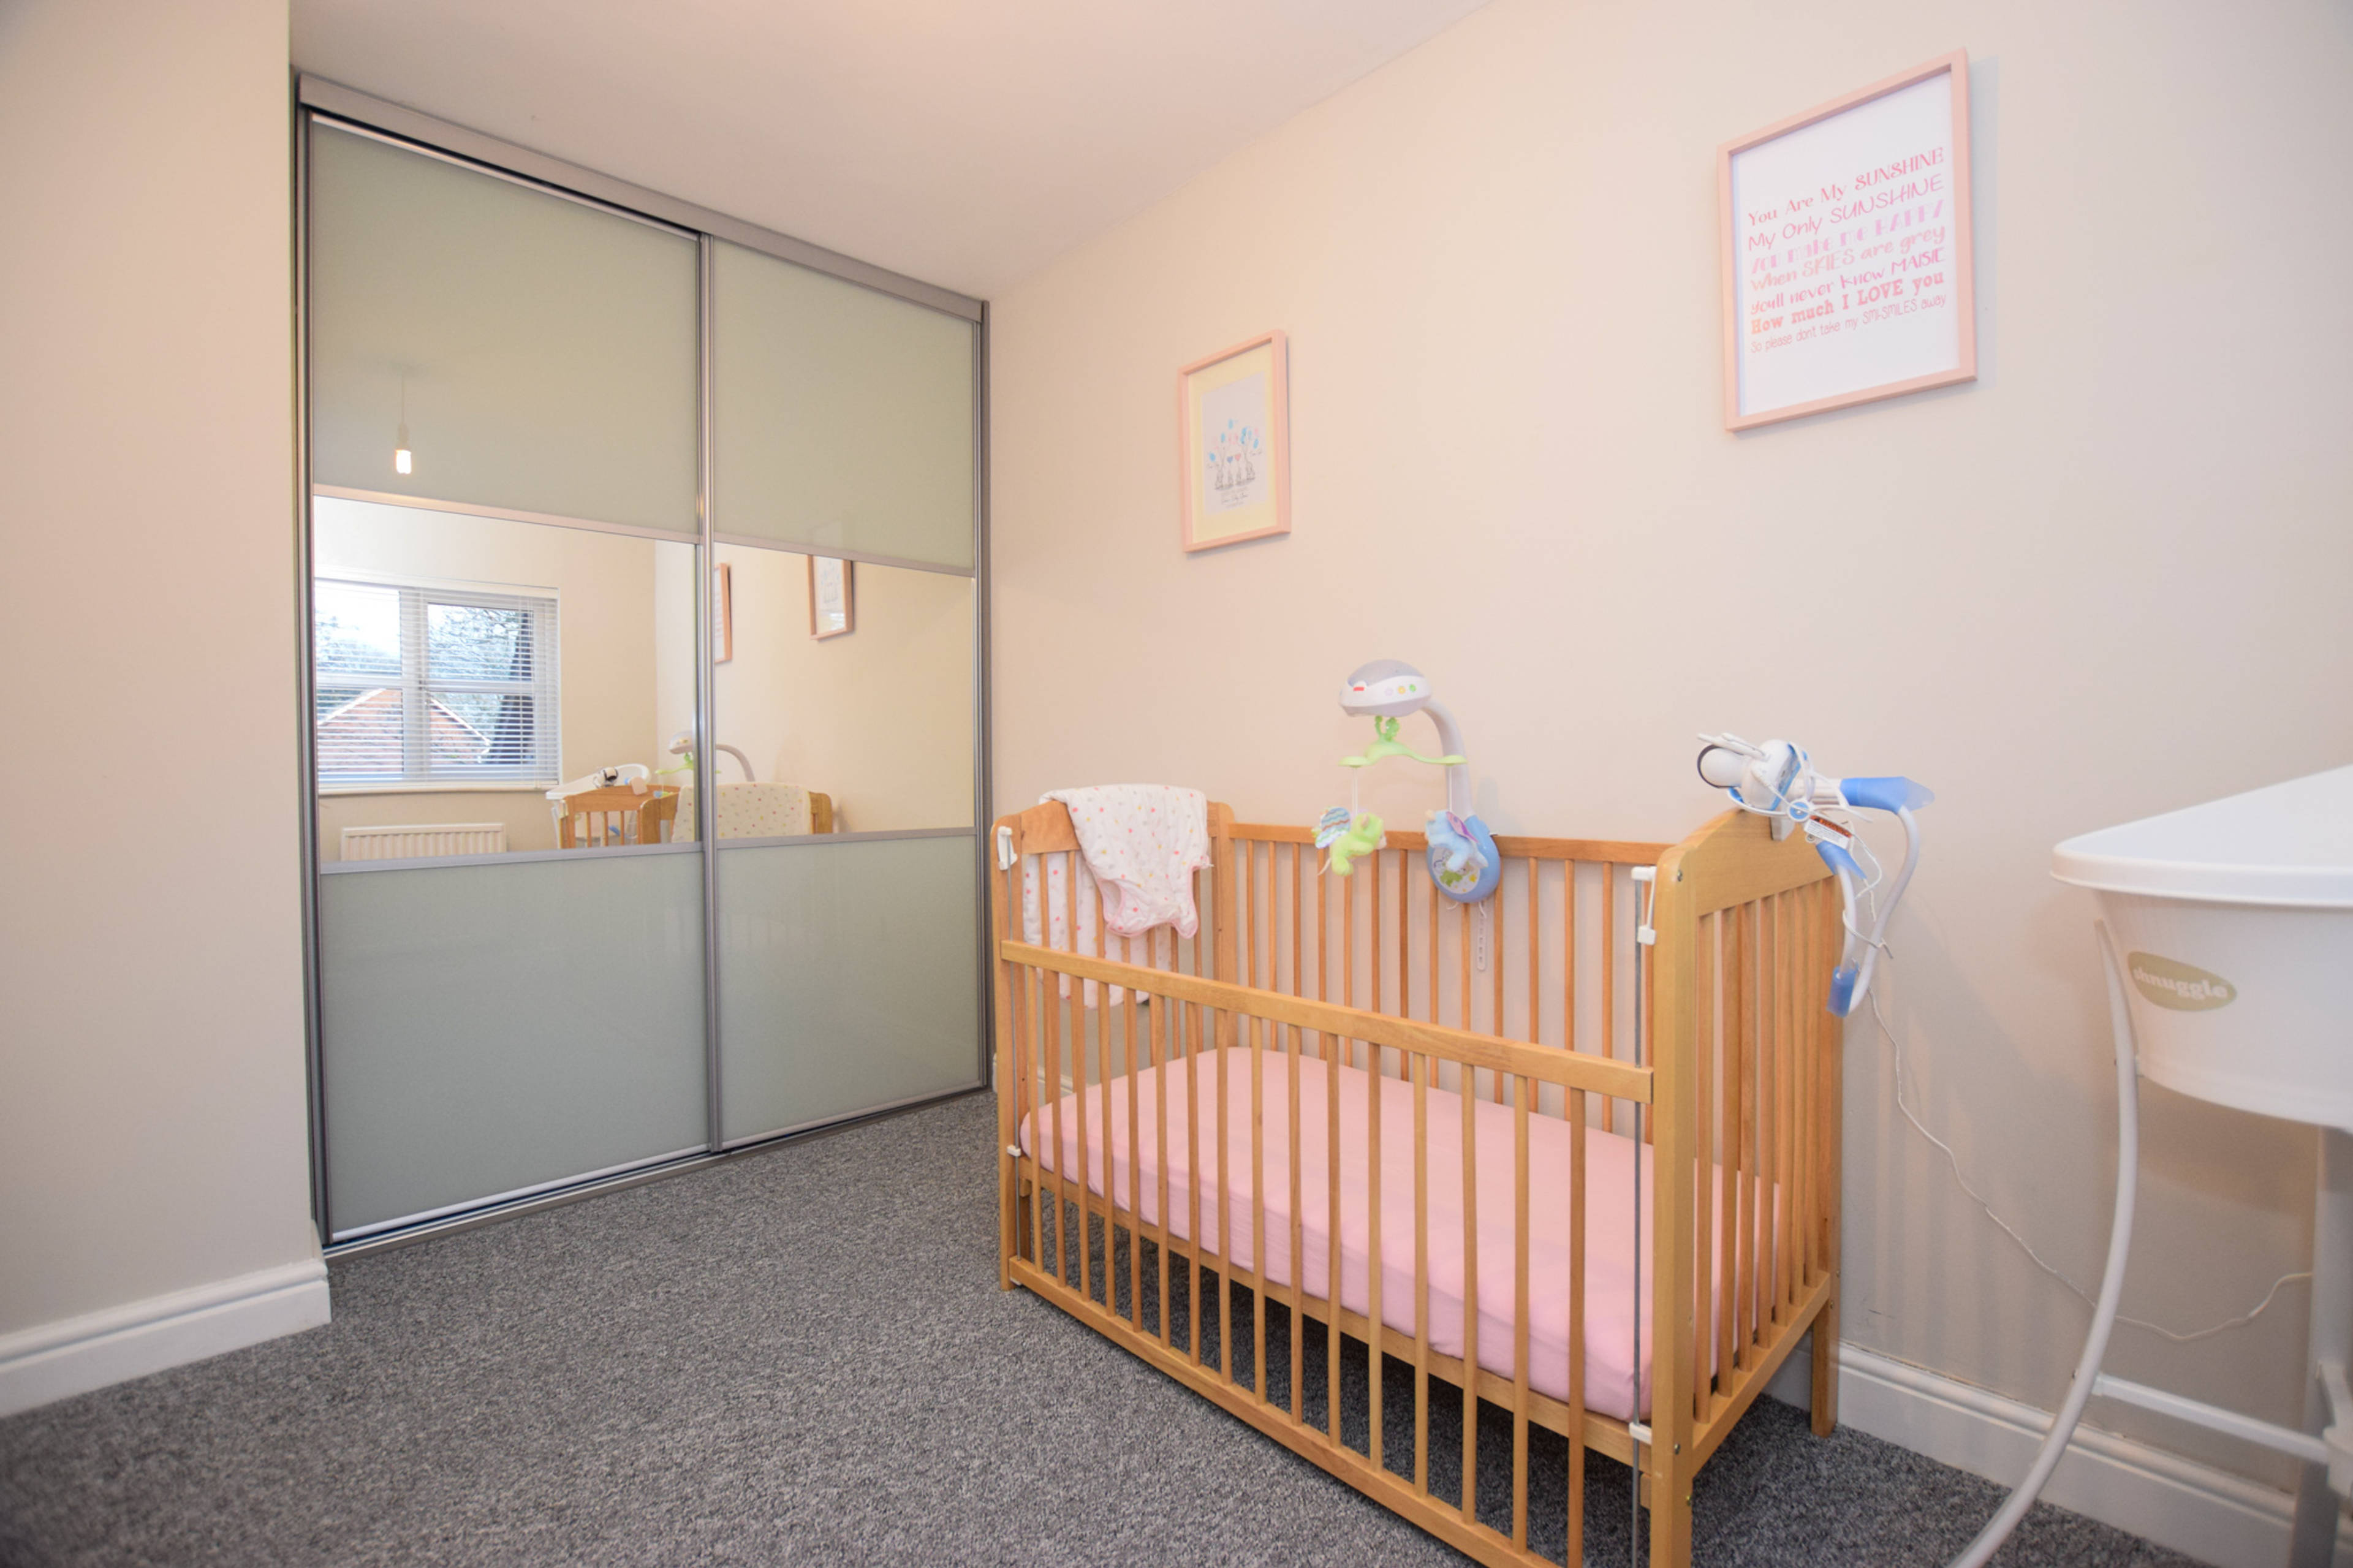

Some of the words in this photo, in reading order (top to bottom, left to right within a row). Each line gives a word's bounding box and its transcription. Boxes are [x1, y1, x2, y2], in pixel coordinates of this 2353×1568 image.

[1748, 208, 1777, 225] You
[1786, 197, 1814, 215] Are
[1821, 184, 1847, 203] My
[1855, 146, 1944, 191] SUNSHINE
[1749, 232, 1776, 251] My
[1783, 215, 1822, 239] Only
[1830, 173, 1944, 224] SUNSHINE
[1860, 241, 1893, 260] are
[1900, 225, 1945, 254] grey
[1751, 316, 1784, 335] How
[1791, 298, 1834, 324] much
[1842, 294, 1849, 310] I
[1857, 278, 1904, 306] LOVE
[1912, 271, 1944, 296] you
[1751, 341, 1762, 354] So
[1765, 334, 1793, 351] please
[1820, 321, 1841, 336] take
[1845, 318, 1859, 331] my
[1921, 294, 1946, 309] away
[1790, 281, 1834, 305] never
